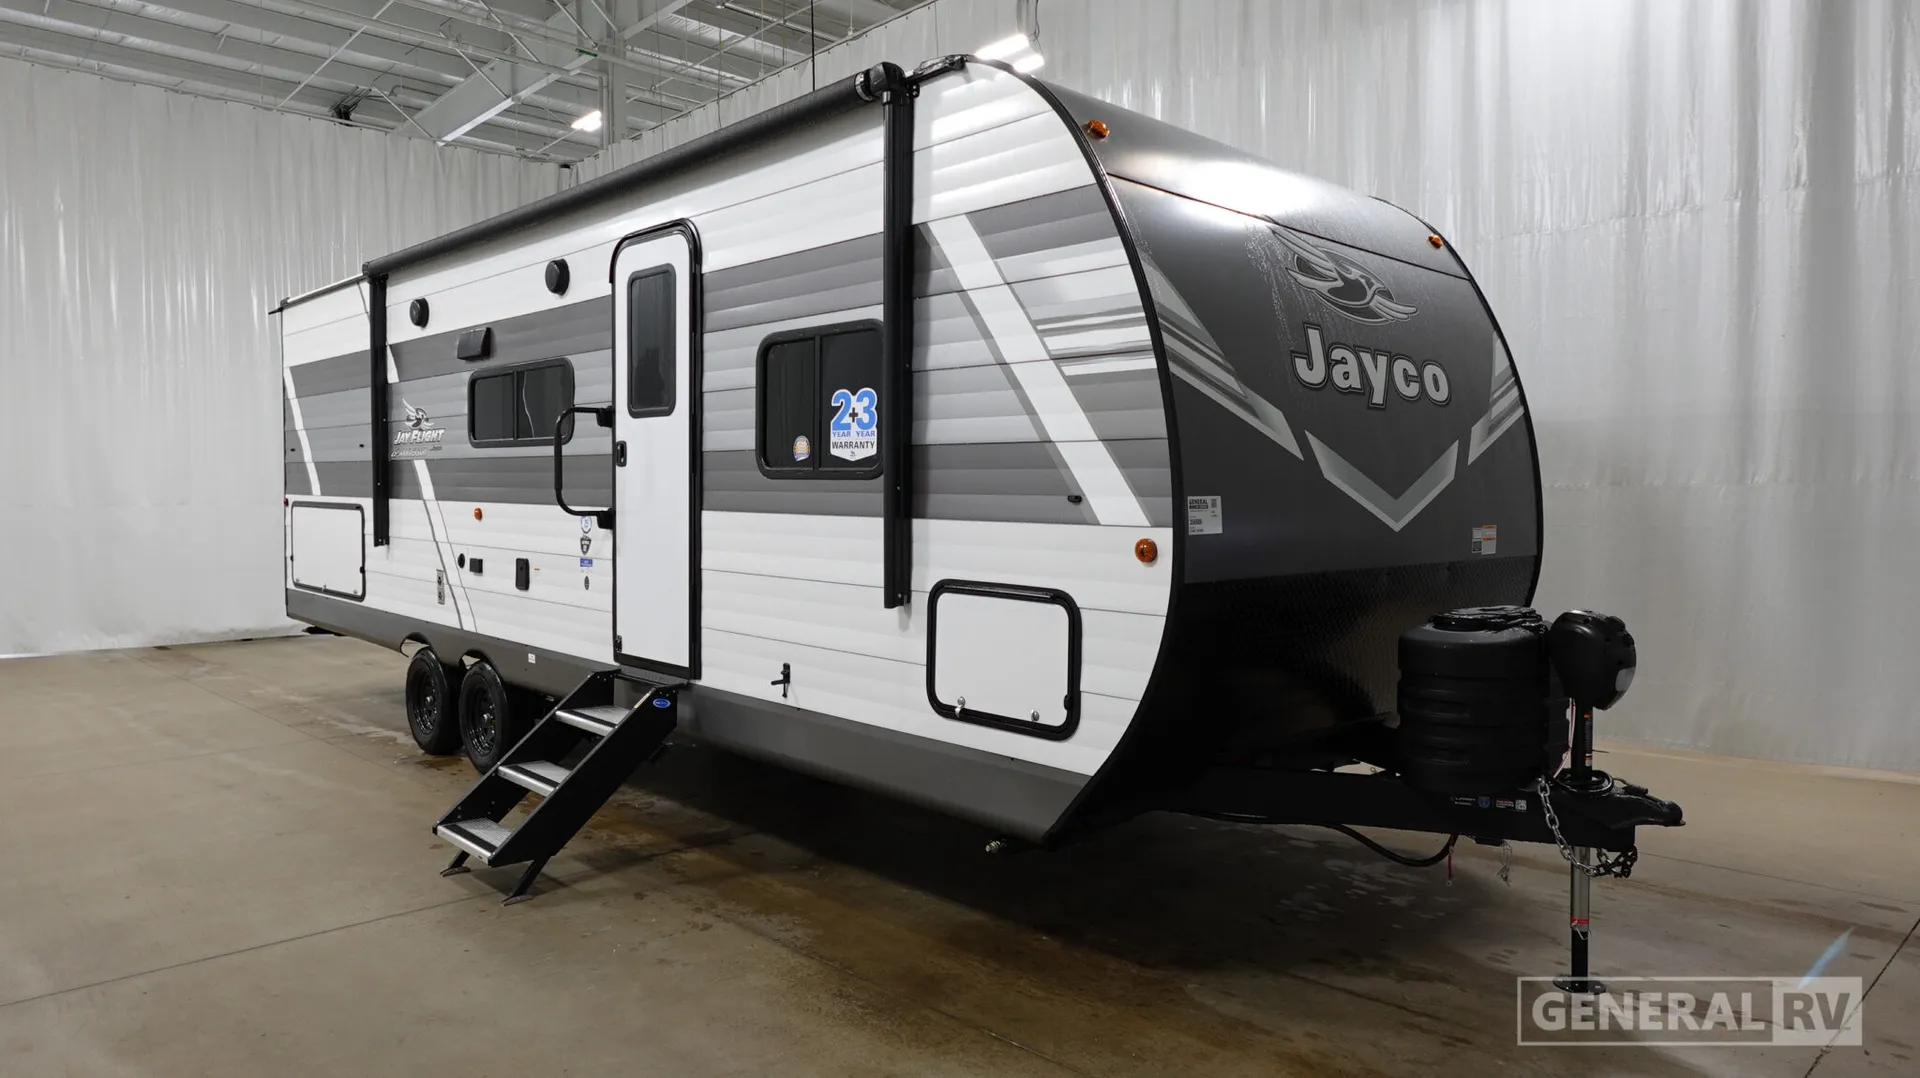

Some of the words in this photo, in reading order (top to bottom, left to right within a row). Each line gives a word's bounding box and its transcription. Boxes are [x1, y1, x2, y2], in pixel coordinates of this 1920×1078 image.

[1292, 324, 1451, 408] Jayco
[411, 429, 446, 443] FLIGHT
[832, 441, 875, 449] WARRANTY
